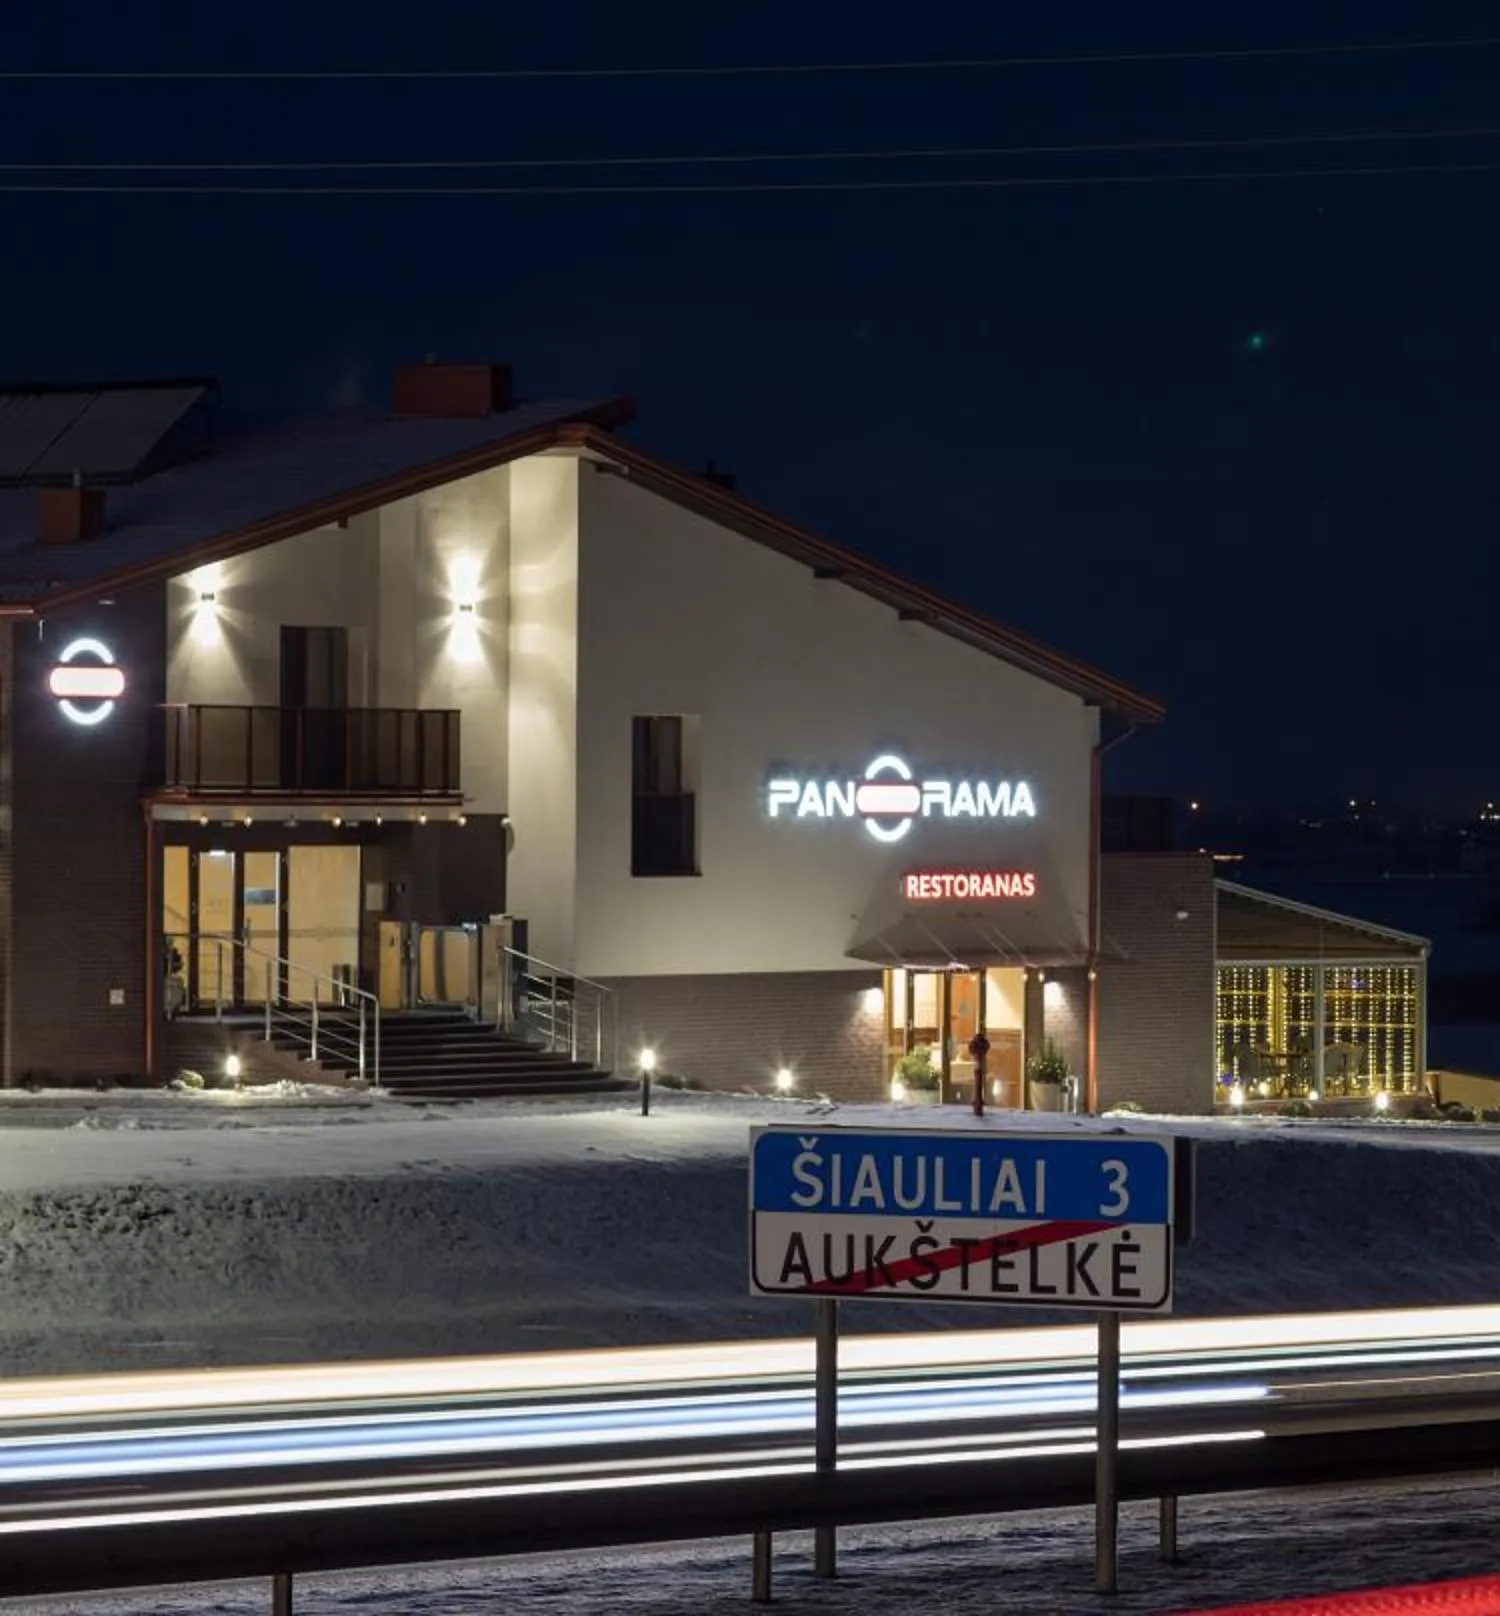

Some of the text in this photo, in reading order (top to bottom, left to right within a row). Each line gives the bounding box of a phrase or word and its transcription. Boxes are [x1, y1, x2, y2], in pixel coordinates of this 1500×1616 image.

[768, 755, 1037, 842] PANORAMA
[906, 873, 1036, 898] RESTORANAS
[790, 1136, 1130, 1217] ŠIAULIAI 3
[779, 1219, 1143, 1298] AUKŠTELKĖ
